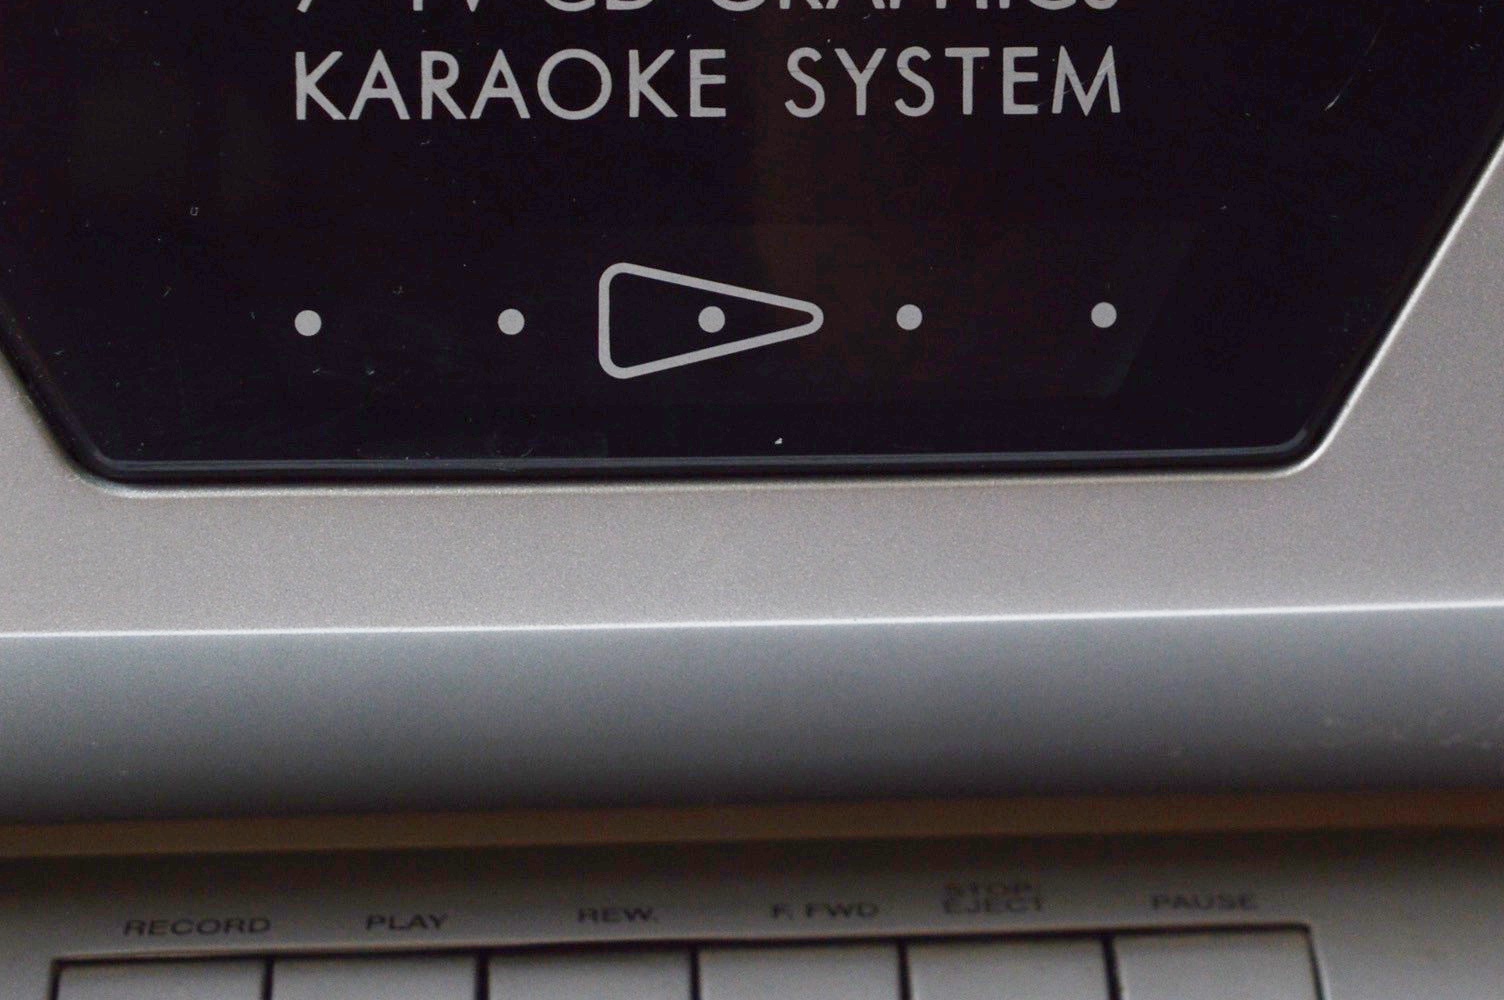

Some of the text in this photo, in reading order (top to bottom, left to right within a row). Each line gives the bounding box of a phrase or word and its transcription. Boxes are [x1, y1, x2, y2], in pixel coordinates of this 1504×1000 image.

[295, 46, 1120, 120] KARAOKE SYSTEM
[1150, 894, 1259, 911] PAUSE
[123, 917, 271, 936] RECORD
[366, 913, 448, 930] PLAY
